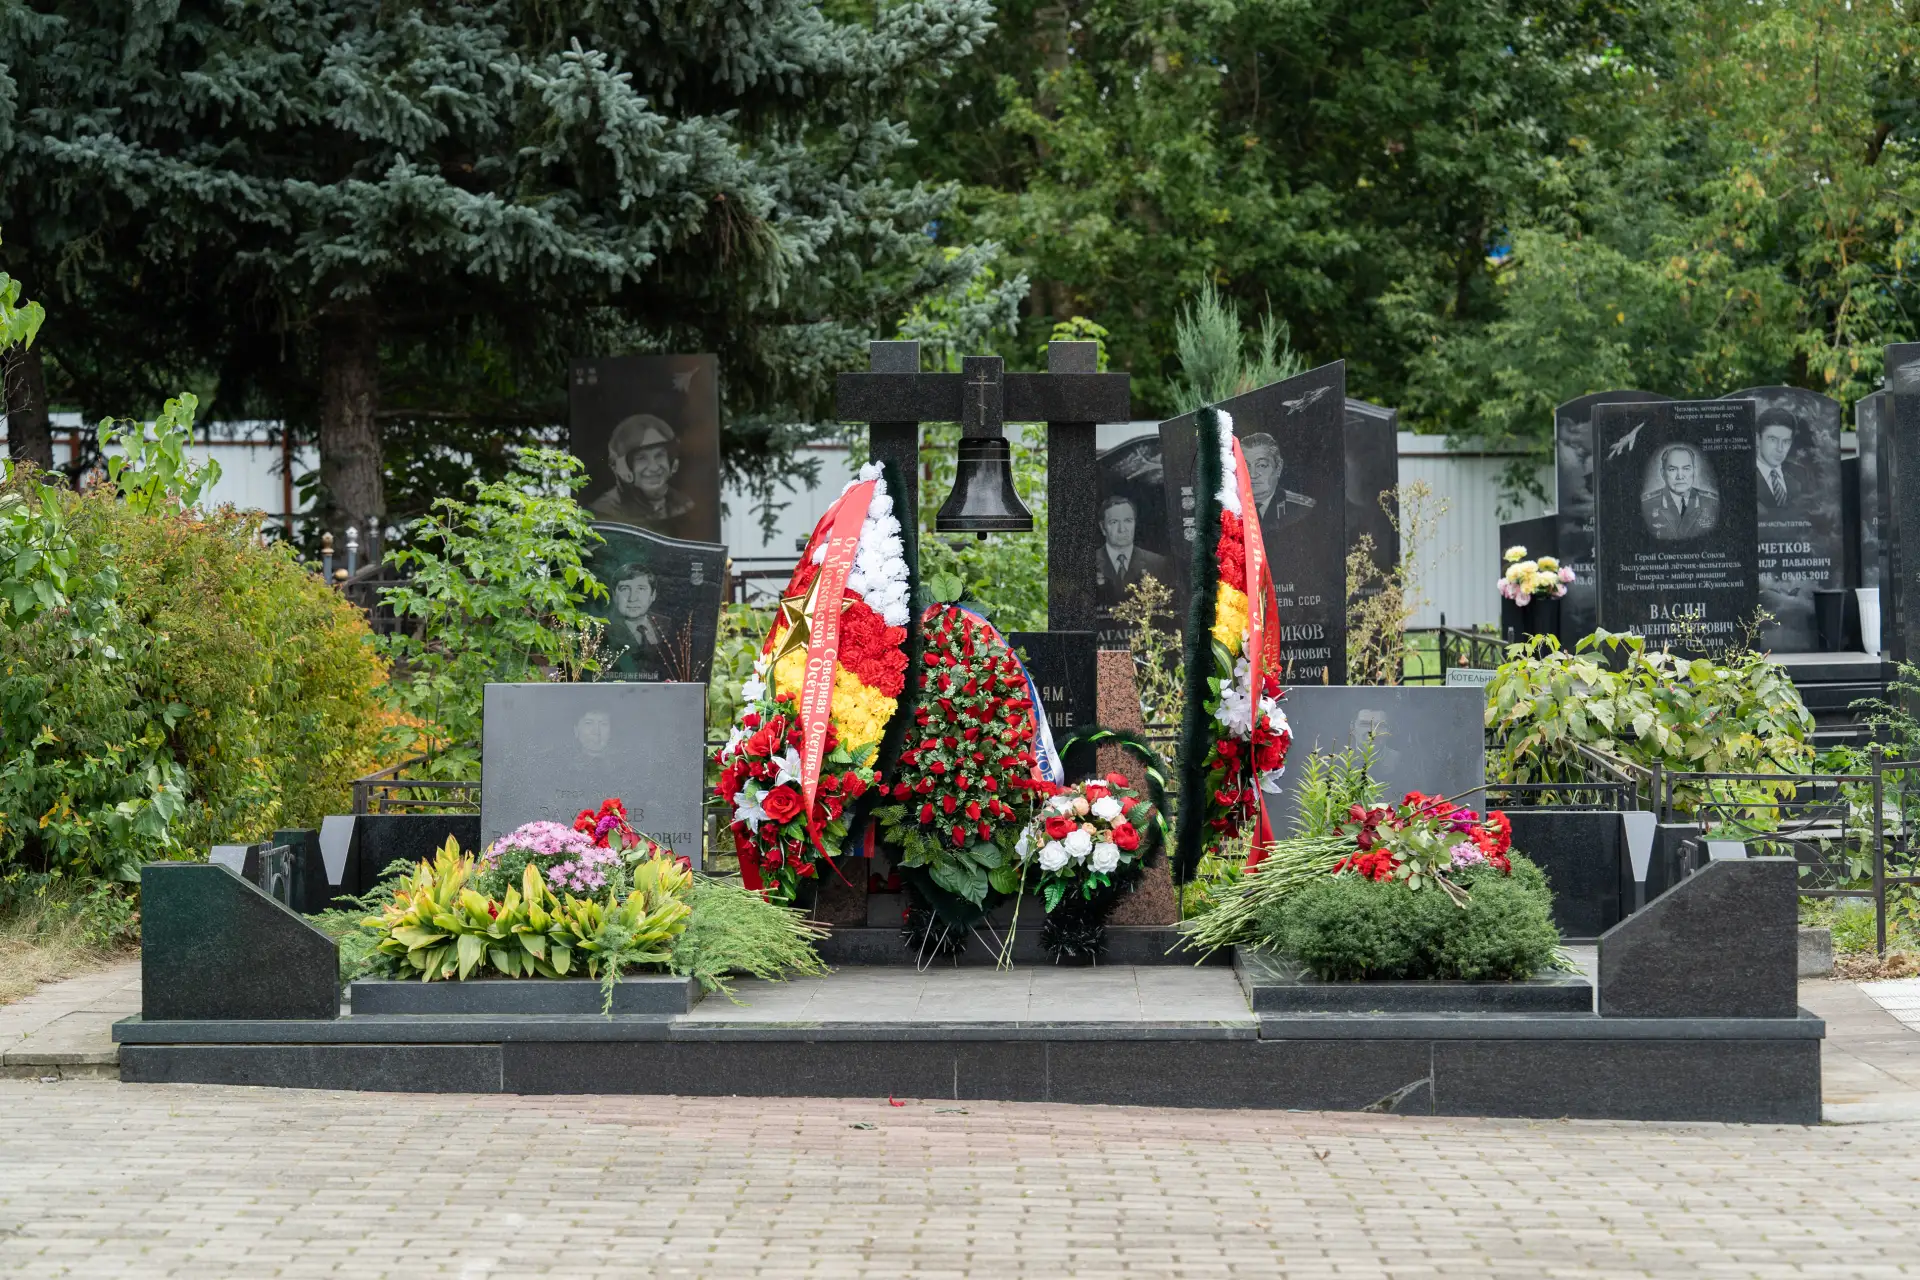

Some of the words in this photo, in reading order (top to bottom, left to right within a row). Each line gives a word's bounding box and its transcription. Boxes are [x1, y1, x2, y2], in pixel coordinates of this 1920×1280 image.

[832, 537, 842, 547] и
[842, 536, 857, 556] От
[1635, 552, 1656, 563] Герой
[1658, 552, 1700, 561] Советского
[1701, 551, 1726, 559] Союза
[1782, 558, 1831, 567] ПАВЛОВИЧ
[1619, 562, 1670, 573] Заслуженный
[1671, 561, 1742, 571] лётчик-испытатель
[1635, 572, 1665, 581] Генерал
[1671, 571, 1694, 581] майор
[1695, 571, 1727, 580] авиации
[1781, 570, 1829, 580] 09.05.2012
[1274, 582, 1294, 593] НЫЙ
[1617, 581, 1655, 591] Почётный
[1656, 582, 1697, 591] гражданин
[1698, 580, 1744, 590] г.Жуковский
[811, 554, 840, 649] Московской
[826, 560, 852, 641] Республики
[1275, 598, 1294, 607] ЕЛЬ
[1298, 595, 1321, 606] СССР
[1650, 603, 1707, 620] ВАСИН
[1629, 623, 1681, 635] ВАЛЕНТИН
[1683, 621, 1734, 634] ПЕТРОВИЧ
[605, 671, 659, 680] ЗАСЛУЖЕННЫЙ
[815, 648, 837, 714] Северная
